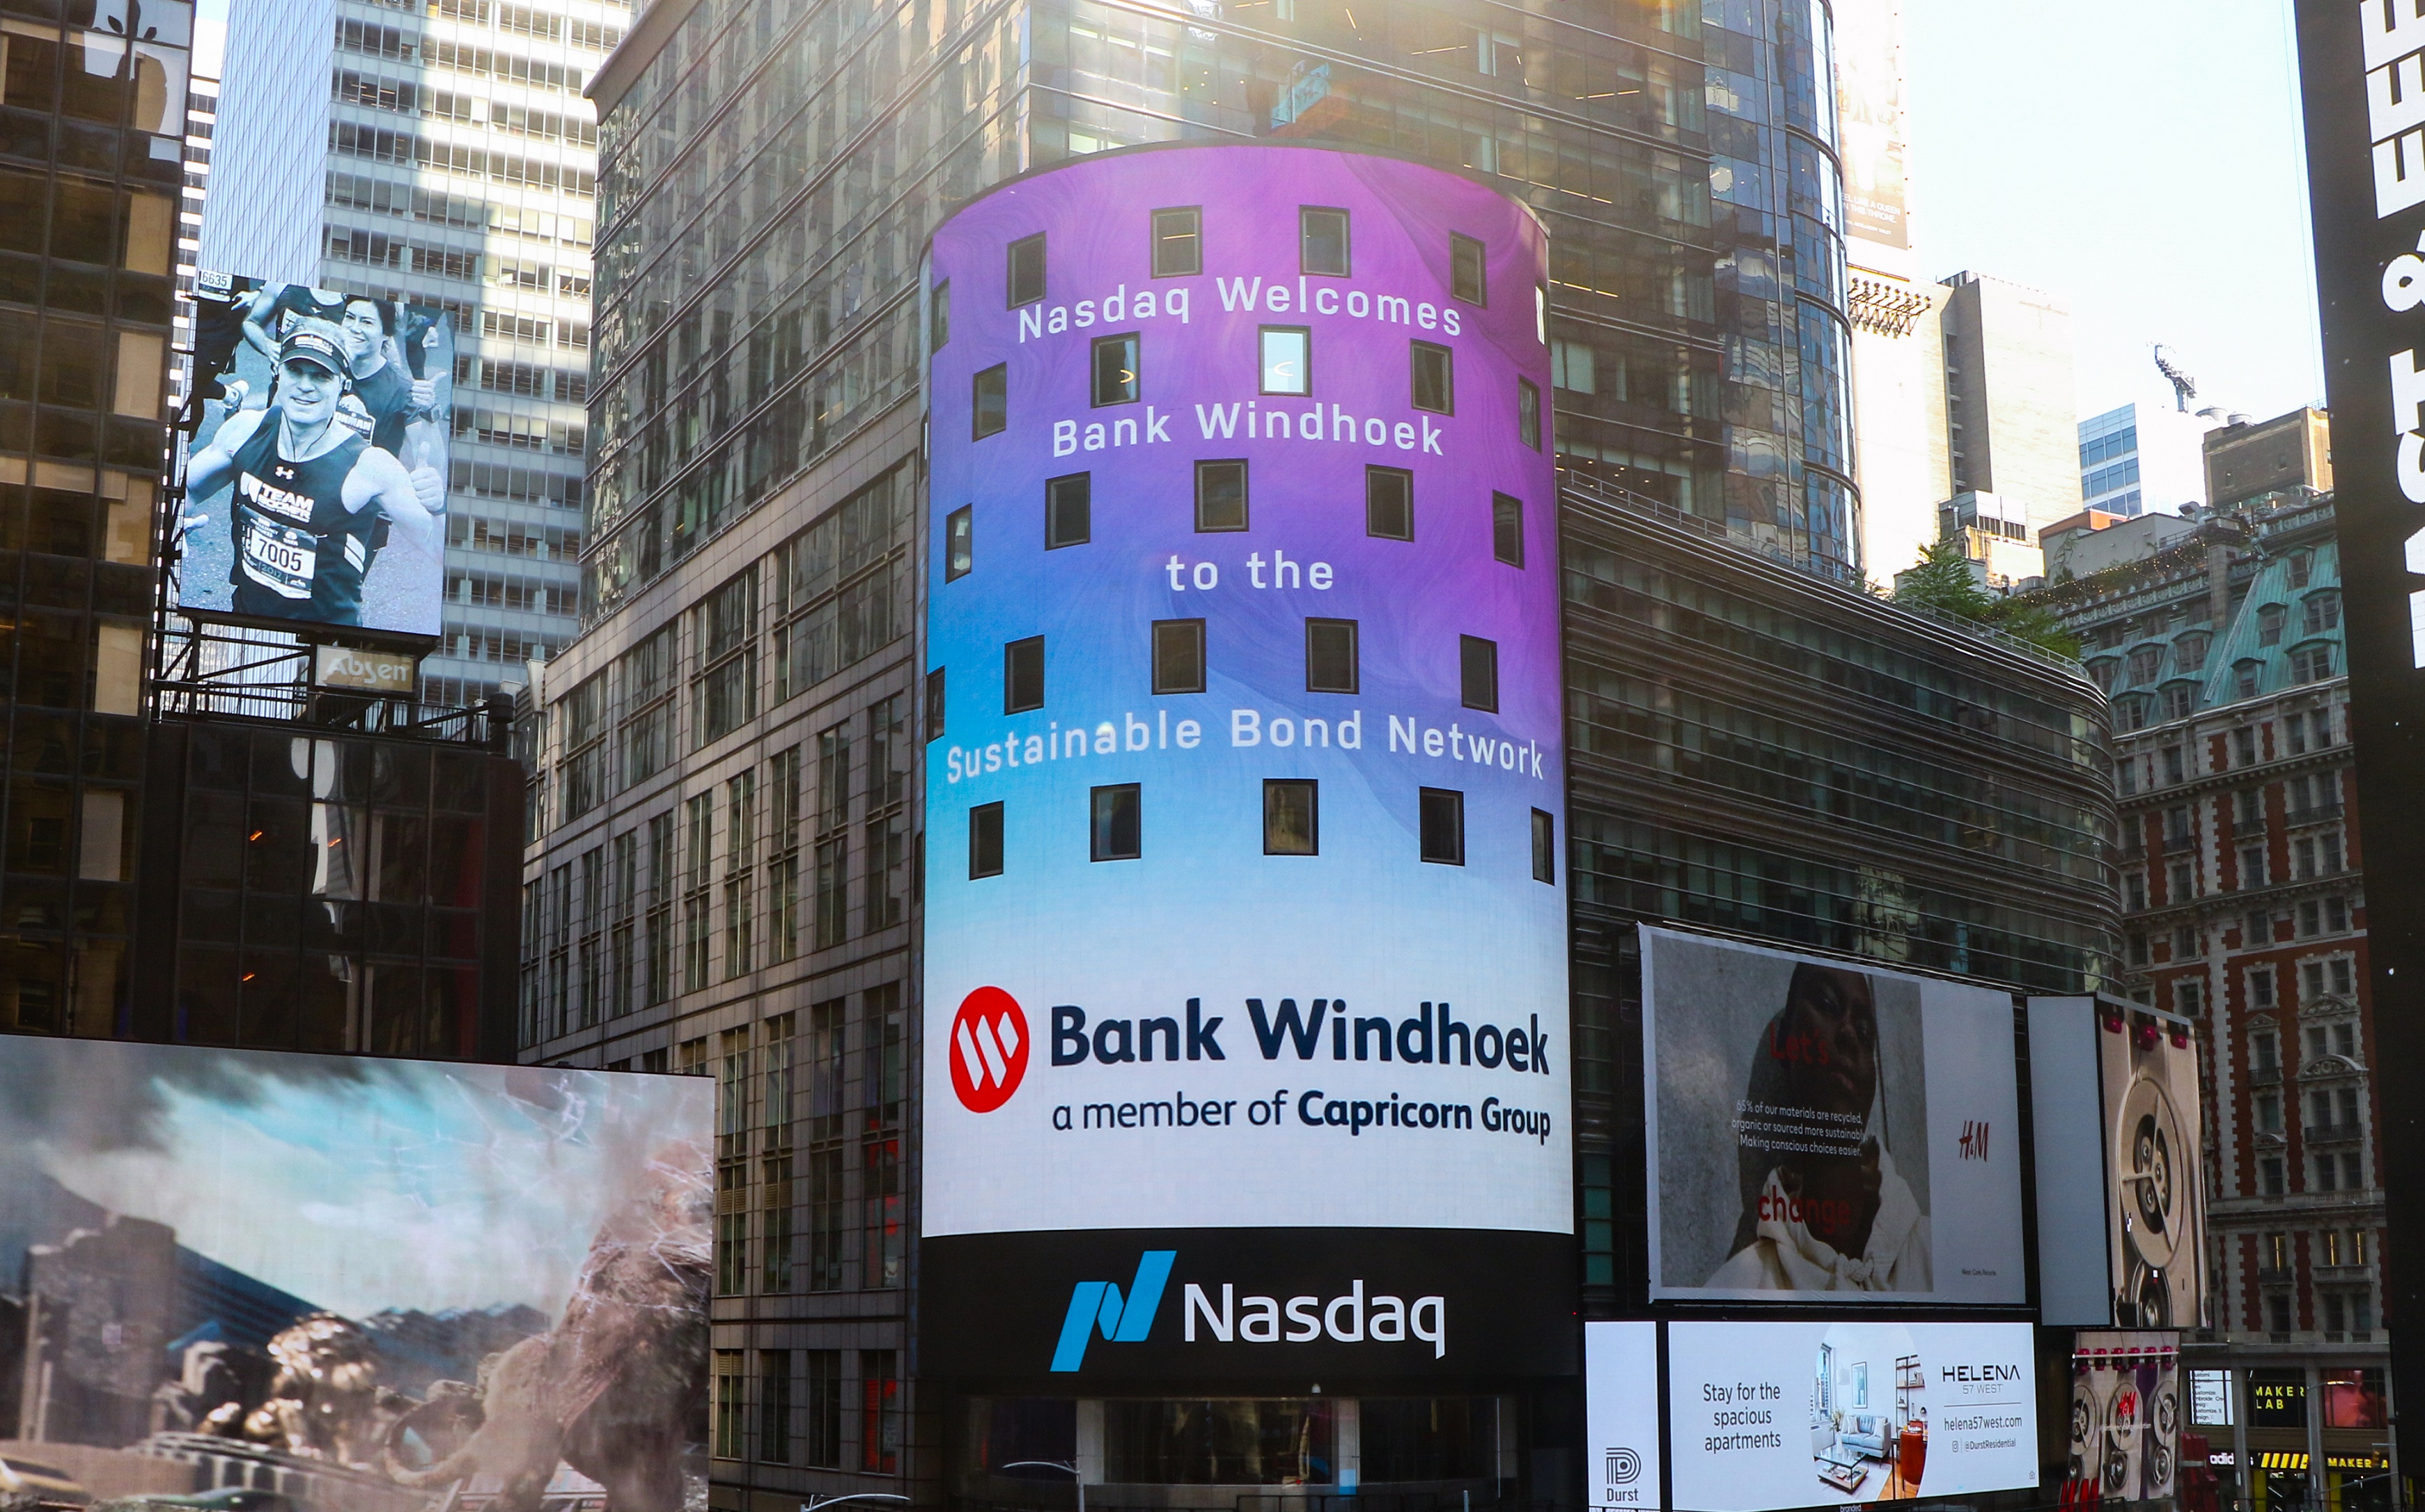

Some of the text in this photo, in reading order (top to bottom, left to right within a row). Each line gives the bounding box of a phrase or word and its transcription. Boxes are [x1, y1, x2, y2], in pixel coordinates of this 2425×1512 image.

[1870, 200, 1876, 209] A
[1876, 202, 1901, 217] QUEEN
[203, 271, 228, 288] 6635
[1019, 276, 1461, 343] Nasdaq Welcomes
[1053, 400, 1444, 458] Bank Windhoek
[257, 493, 312, 520] BOOMER
[262, 483, 315, 512] TEAM
[258, 538, 302, 572] 7005
[261, 563, 283, 578] 2017
[1167, 550, 1334, 591] to the
[326, 655, 410, 685] Absen
[947, 708, 1543, 784] Sustainable Bond Network
[1050, 997, 1550, 1075] Bank Windhoek
[1052, 1089, 1551, 1146] a member of Capricorn Group
[1736, 1099, 1863, 1125] 65% of our materials are recycled,
[1731, 1119, 1762, 1132] organic
[1763, 1121, 1772, 1131] or
[1772, 1123, 1804, 1135] sourced
[1804, 1126, 1825, 1137] more
[1740, 1134, 1862, 1158] Making conscious choices easier.
[1958, 1120, 1989, 1163] H&M
[1758, 1185, 1850, 1234] change
[1184, 1279, 1446, 1359] Nasdaq
[1942, 1364, 2021, 1382] HELENA
[1703, 1381, 1781, 1405] Stay for the
[1962, 1383, 2004, 1394] 57 WEST
[2256, 1398, 2284, 1410] LAB
[1713, 1405, 1772, 1430] spacious
[1944, 1415, 2023, 1431] helena57west.com
[1704, 1430, 1781, 1455] apartments
[1964, 1437, 2017, 1452] @DurstResidential
[2209, 1452, 2254, 1466] adids
[2327, 1457, 2373, 1469] MAKER
[1606, 1487, 1639, 1502] Durst
